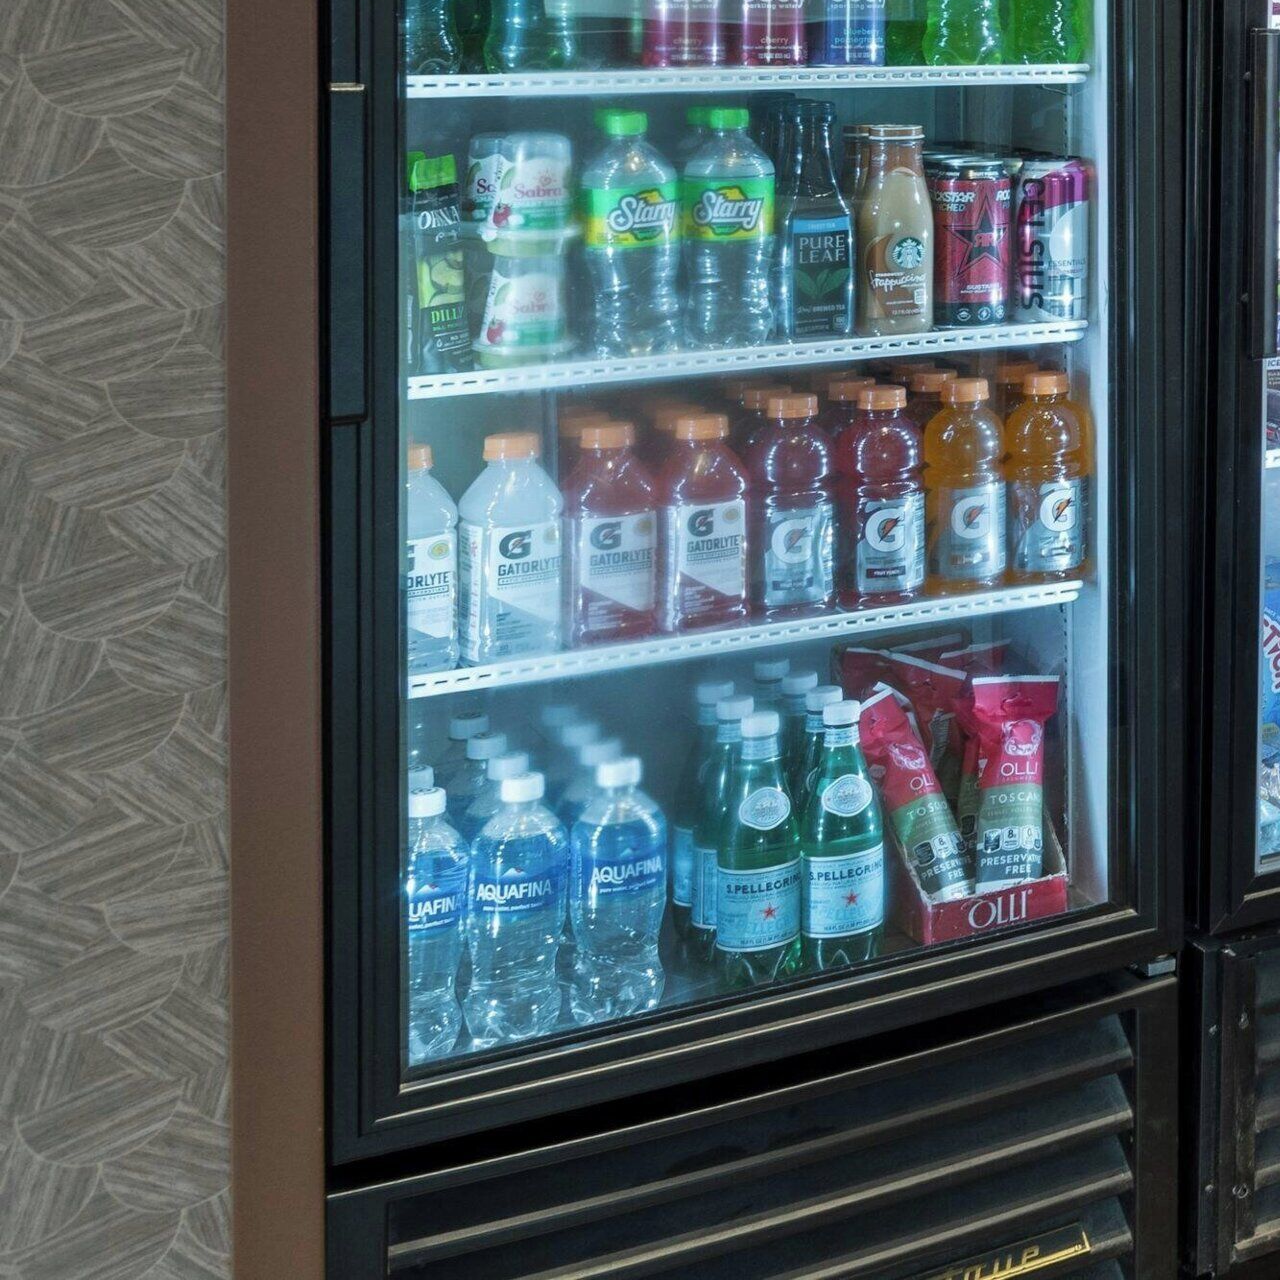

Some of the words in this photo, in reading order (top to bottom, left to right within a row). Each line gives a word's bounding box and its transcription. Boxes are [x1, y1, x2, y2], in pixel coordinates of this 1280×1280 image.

[514, 184, 562, 198] Sabra
[608, 191, 676, 231] Starry
[695, 191, 764, 228] Starry
[800, 235, 845, 249] PURE
[800, 249, 845, 264] LEAF
[687, 534, 740, 551] GATORLYTE
[498, 556, 561, 576] GATORLYTE
[589, 547, 652, 567] GATORLYTE
[1001, 762, 1038, 776] OLLI
[590, 856, 662, 884] AQUAFINA
[1005, 865, 1031, 875] FREE
[477, 880, 552, 902] AQUAFINA
[968, 889, 1033, 929] OLLI
